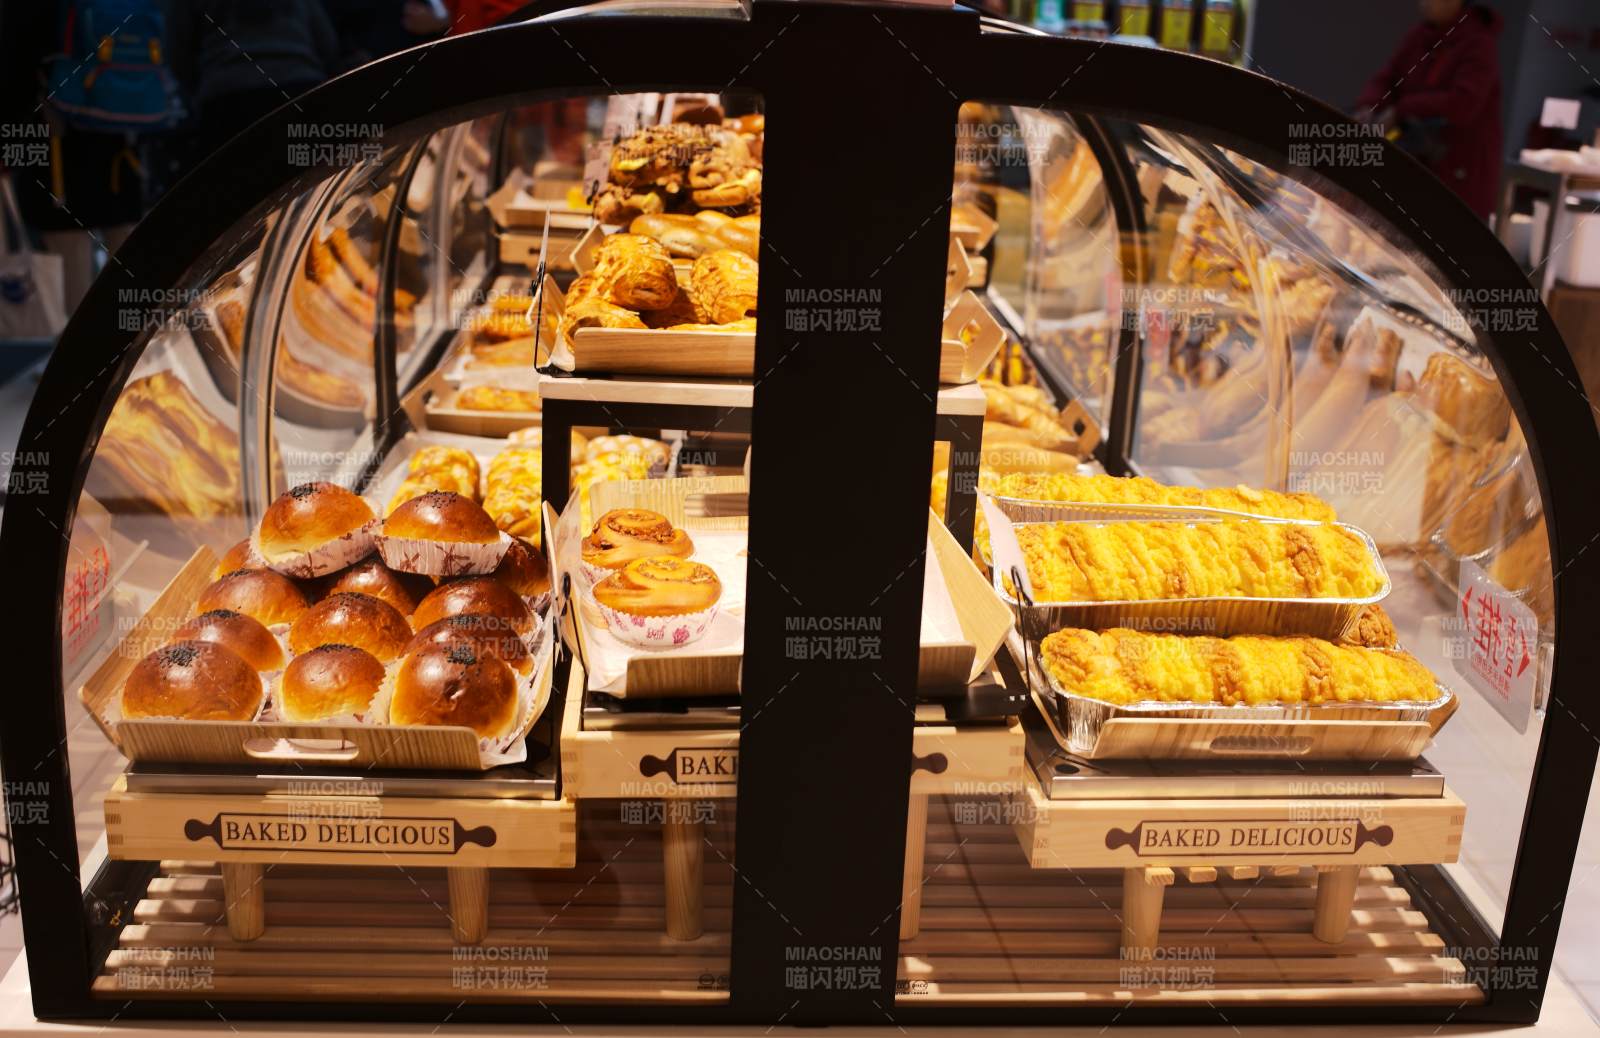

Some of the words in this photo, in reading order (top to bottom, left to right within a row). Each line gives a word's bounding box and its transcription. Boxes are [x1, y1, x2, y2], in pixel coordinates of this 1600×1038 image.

[226, 821, 307, 842] BAKED
[318, 823, 450, 845] DELICIOUS
[1144, 829, 1220, 847] BAKED
[1230, 827, 1353, 847] DELICIOUS
